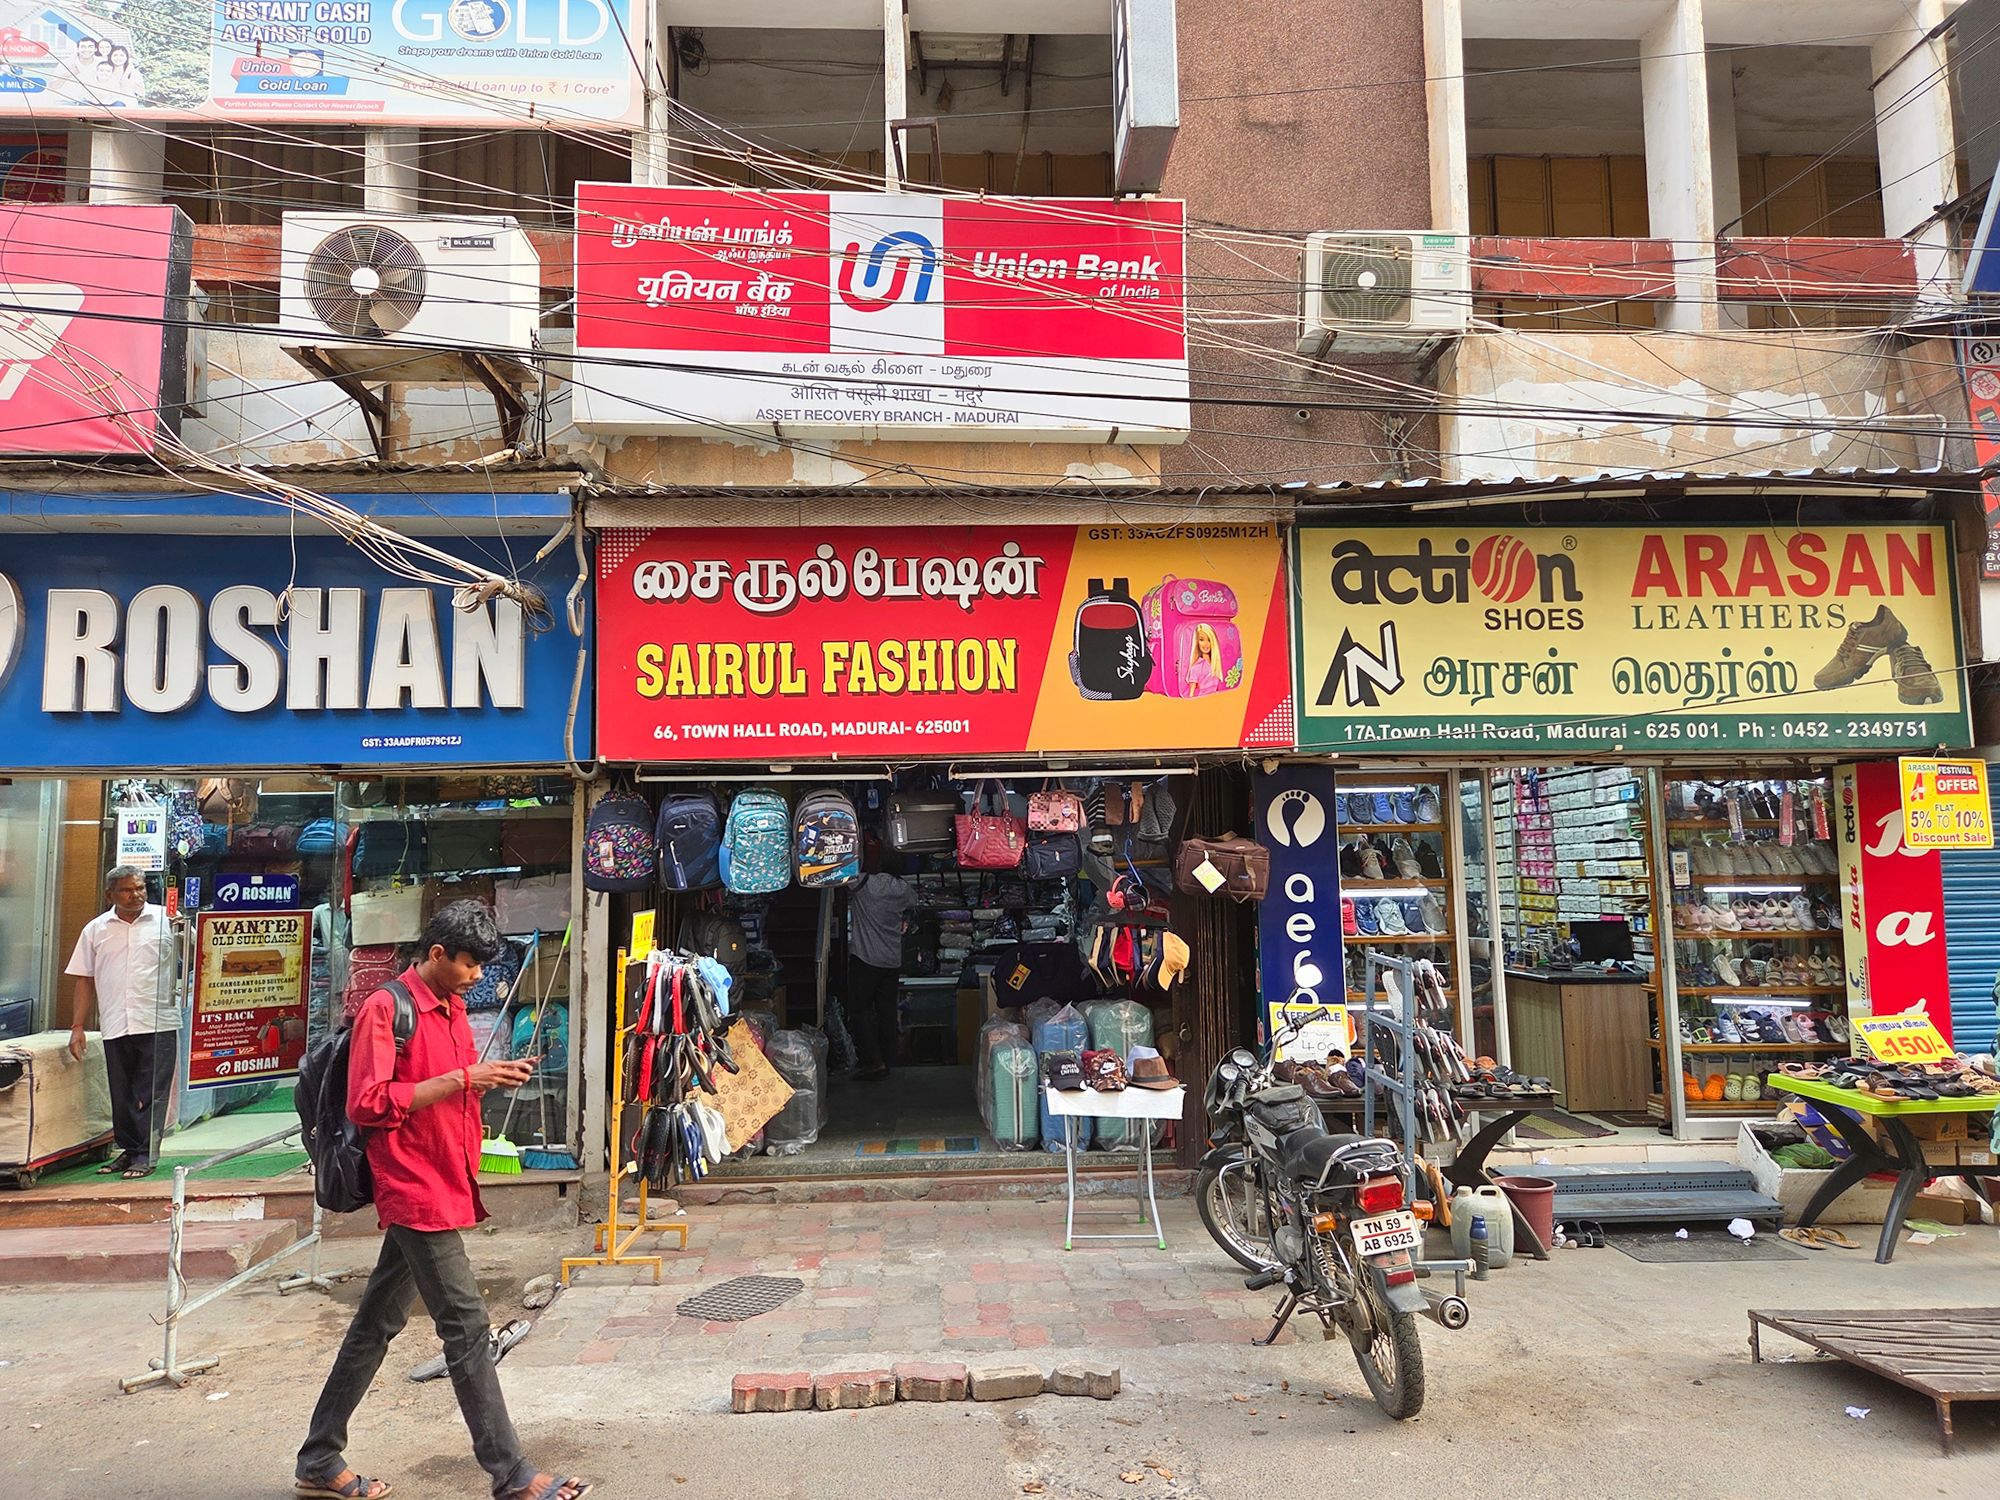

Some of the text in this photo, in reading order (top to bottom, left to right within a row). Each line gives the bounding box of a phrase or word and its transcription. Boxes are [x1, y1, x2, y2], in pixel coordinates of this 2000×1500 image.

[225, 1, 371, 22] INSTANT CASH
[221, 25, 372, 44] AGAINST GOLD
[398, 46, 602, 60] Shape your dreams with Union Gold Loan
[240, 61, 281, 73] Union
[258, 80, 328, 92] Gold Loan
[473, 81, 505, 92] Loan
[510, 83, 526, 95] up
[530, 82, 543, 93] to
[973, 251, 1161, 282] Union Bank
[637, 270, 742, 309] यूनियन
[1099, 284, 1160, 300] of India
[781, 359, 820, 375] கடன்
[824, 360, 866, 377] வசூல்
[871, 358, 923, 376] கிளை
[941, 365, 993, 379] மதுரை
[891, 388, 932, 402] शाखा
[755, 408, 801, 421] ASSET
[804, 410, 880, 422] RECOVERY
[884, 411, 943, 423] BRANCH
[954, 412, 1019, 424] MADURAI
[1088, 528, 1123, 540] GST:
[1631, 531, 1936, 598] ARASAN
[1198, 589, 1228, 603] Barbie
[1484, 607, 1585, 631] SHOES
[1631, 602, 1849, 630] LEATHERS
[42, 584, 524, 713] ROSHAN
[1116, 634, 1141, 685] Skybags
[635, 638, 1017, 698] SAIRUL FASHION
[1423, 645, 1799, 707] அரசன் லெதர்ஸ்
[653, 725, 679, 741] 66,
[682, 724, 729, 739] TOWN
[733, 723, 776, 738] HALL
[779, 722, 828, 739] ROAD,
[915, 719, 970, 734] 625001
[1437, 723, 1477, 739] Hall
[1482, 723, 1541, 742] Road,
[1546, 722, 1628, 740] Madurai
[1645, 722, 1683, 739] 625
[1738, 721, 1765, 738] Ph
[1782, 721, 1829, 737] 0452
[1847, 721, 1928, 738] 2349751
[362, 736, 462, 748] GST: 33AADFR0579C1ZJ
[1938, 766, 1972, 775] FESTIVAL
[1937, 779, 1978, 792] OFFER
[1935, 804, 1954, 812] FLAT
[1911, 811, 1984, 828] 5% TO 10%
[1912, 832, 1987, 842] Discount Sale
[242, 886, 292, 901] ROSHAN
[1848, 864, 1861, 932] Bata
[212, 919, 299, 935] WANTED
[212, 933, 298, 946] OLD SUITCASES
[208, 980, 240, 988] EXCHANGE
[201, 1010, 255, 1023] IT'S BACK
[217, 1027, 244, 1035] Exchange
[1884, 1034, 1945, 1056] 150/-
[233, 1056, 279, 1074] ROSHAN
[1364, 1217, 1401, 1235] TN 59
[1364, 1231, 1414, 1252] AB 6925
